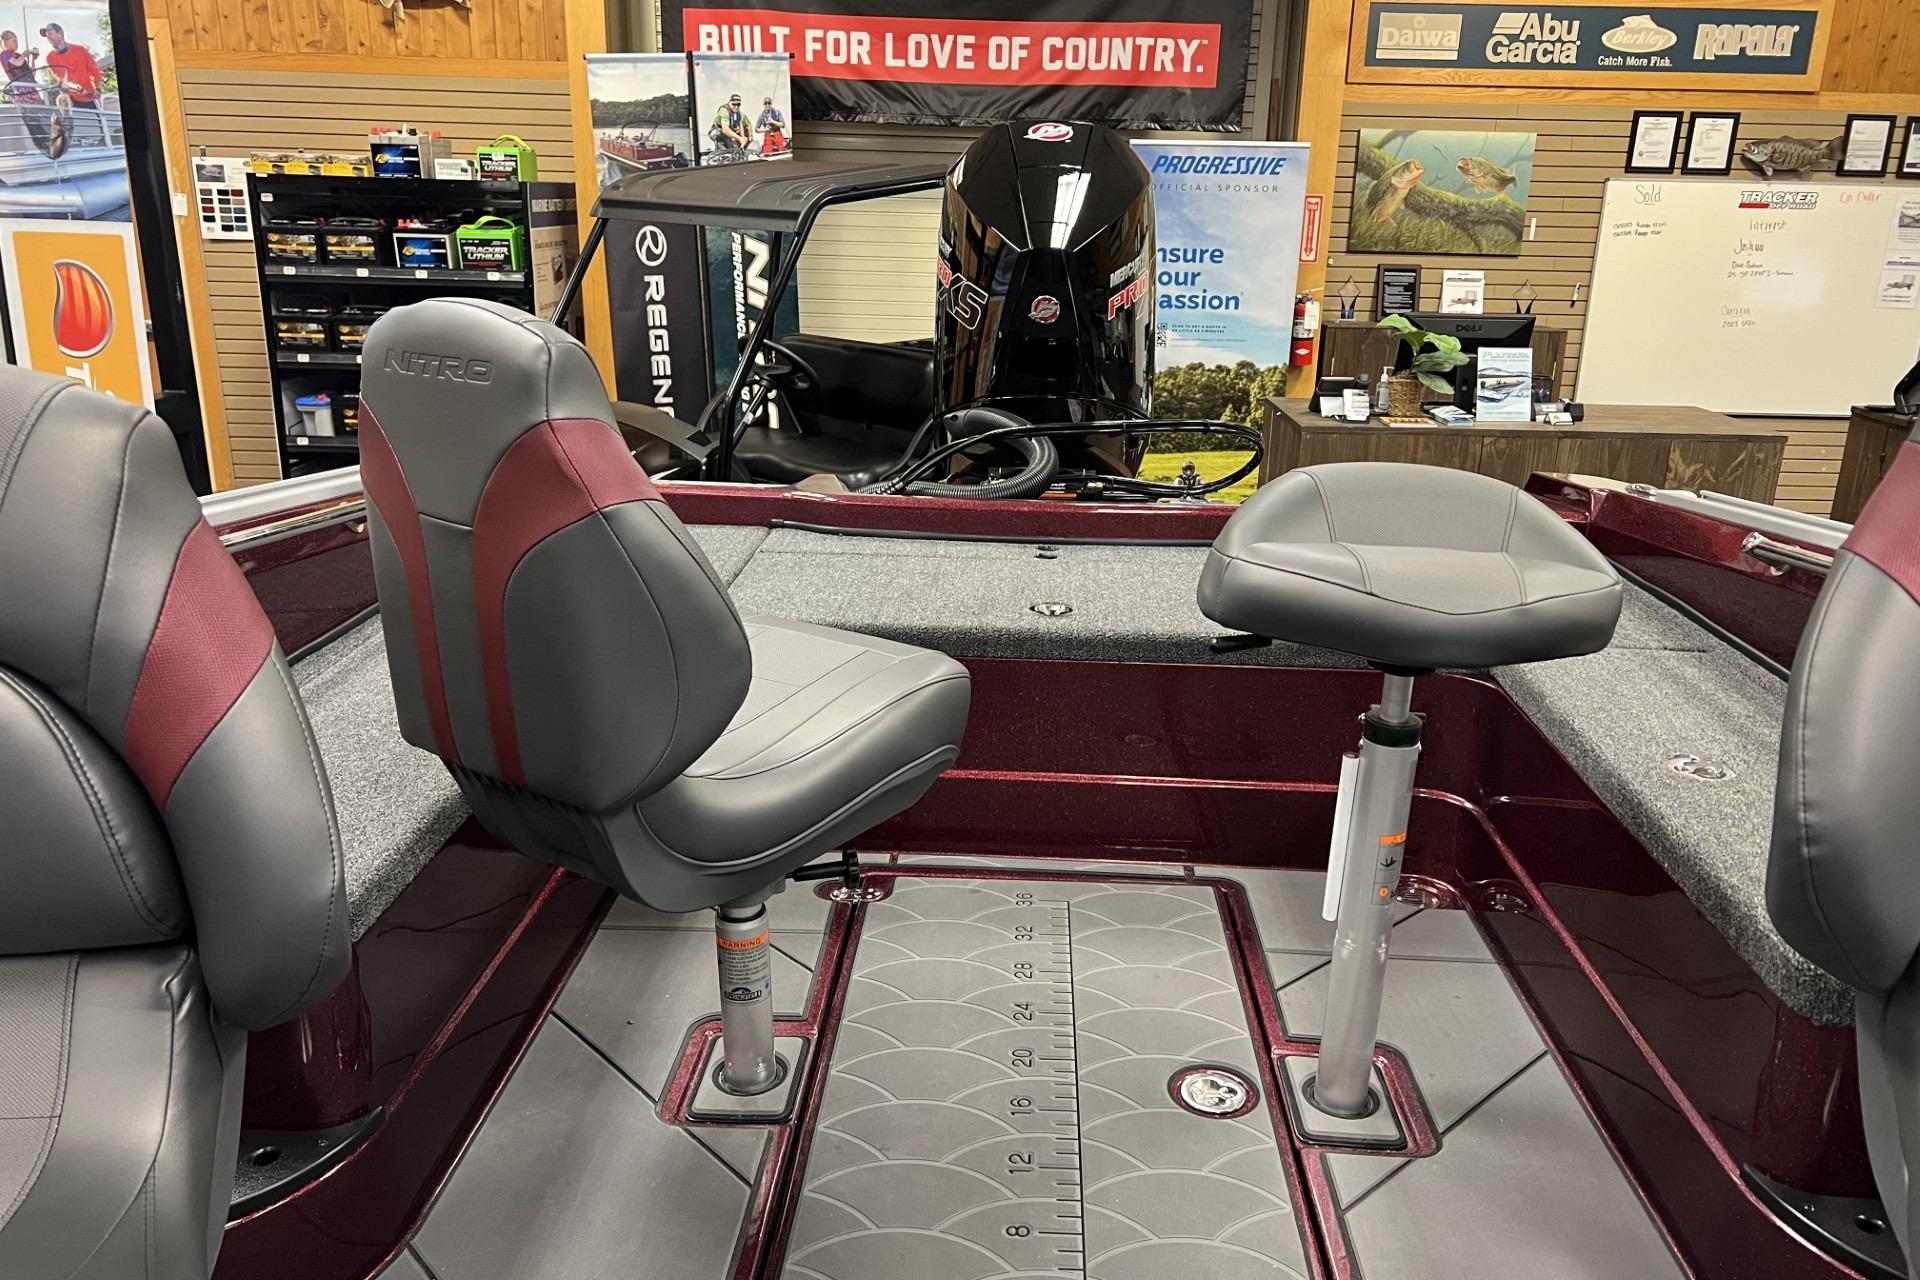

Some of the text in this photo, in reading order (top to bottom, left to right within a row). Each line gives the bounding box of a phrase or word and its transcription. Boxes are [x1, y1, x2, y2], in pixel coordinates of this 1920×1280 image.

[1519, 13, 1580, 42] Abu
[1382, 28, 1458, 47] Daiwa
[1612, 30, 1668, 49] Berkley
[805, 28, 872, 65] FOR
[885, 32, 976, 69] LOVE
[988, 36, 1031, 71] OF
[1485, 35, 1578, 64] Garcia
[1598, 56, 1673, 67] Catch More Fish.
[1151, 155, 1287, 175] PROGRESSIVE
[1217, 184, 1278, 193] SPONSOR
[1634, 184, 1662, 205] Sold
[1740, 191, 1819, 204] TRACKER
[463, 246, 509, 255] TRACKER
[1157, 247, 1224, 264] nsure
[1158, 270, 1201, 287] our
[1108, 270, 1149, 321] PRO
[1158, 289, 1240, 310] assion
[1455, 324, 1483, 333] DELL
[384, 347, 495, 385] NITRO
[1016, 892, 1033, 907] 36
[1014, 925, 1032, 941] 32
[721, 937, 761, 948] WARNING
[1014, 962, 1032, 979] 28
[1012, 1002, 1033, 1021] 24
[1011, 1048, 1032, 1068] 20
[1009, 1098, 1032, 1116] 16
[1008, 1153, 1032, 1174] 12
[1005, 1225, 1030, 1238] 8
